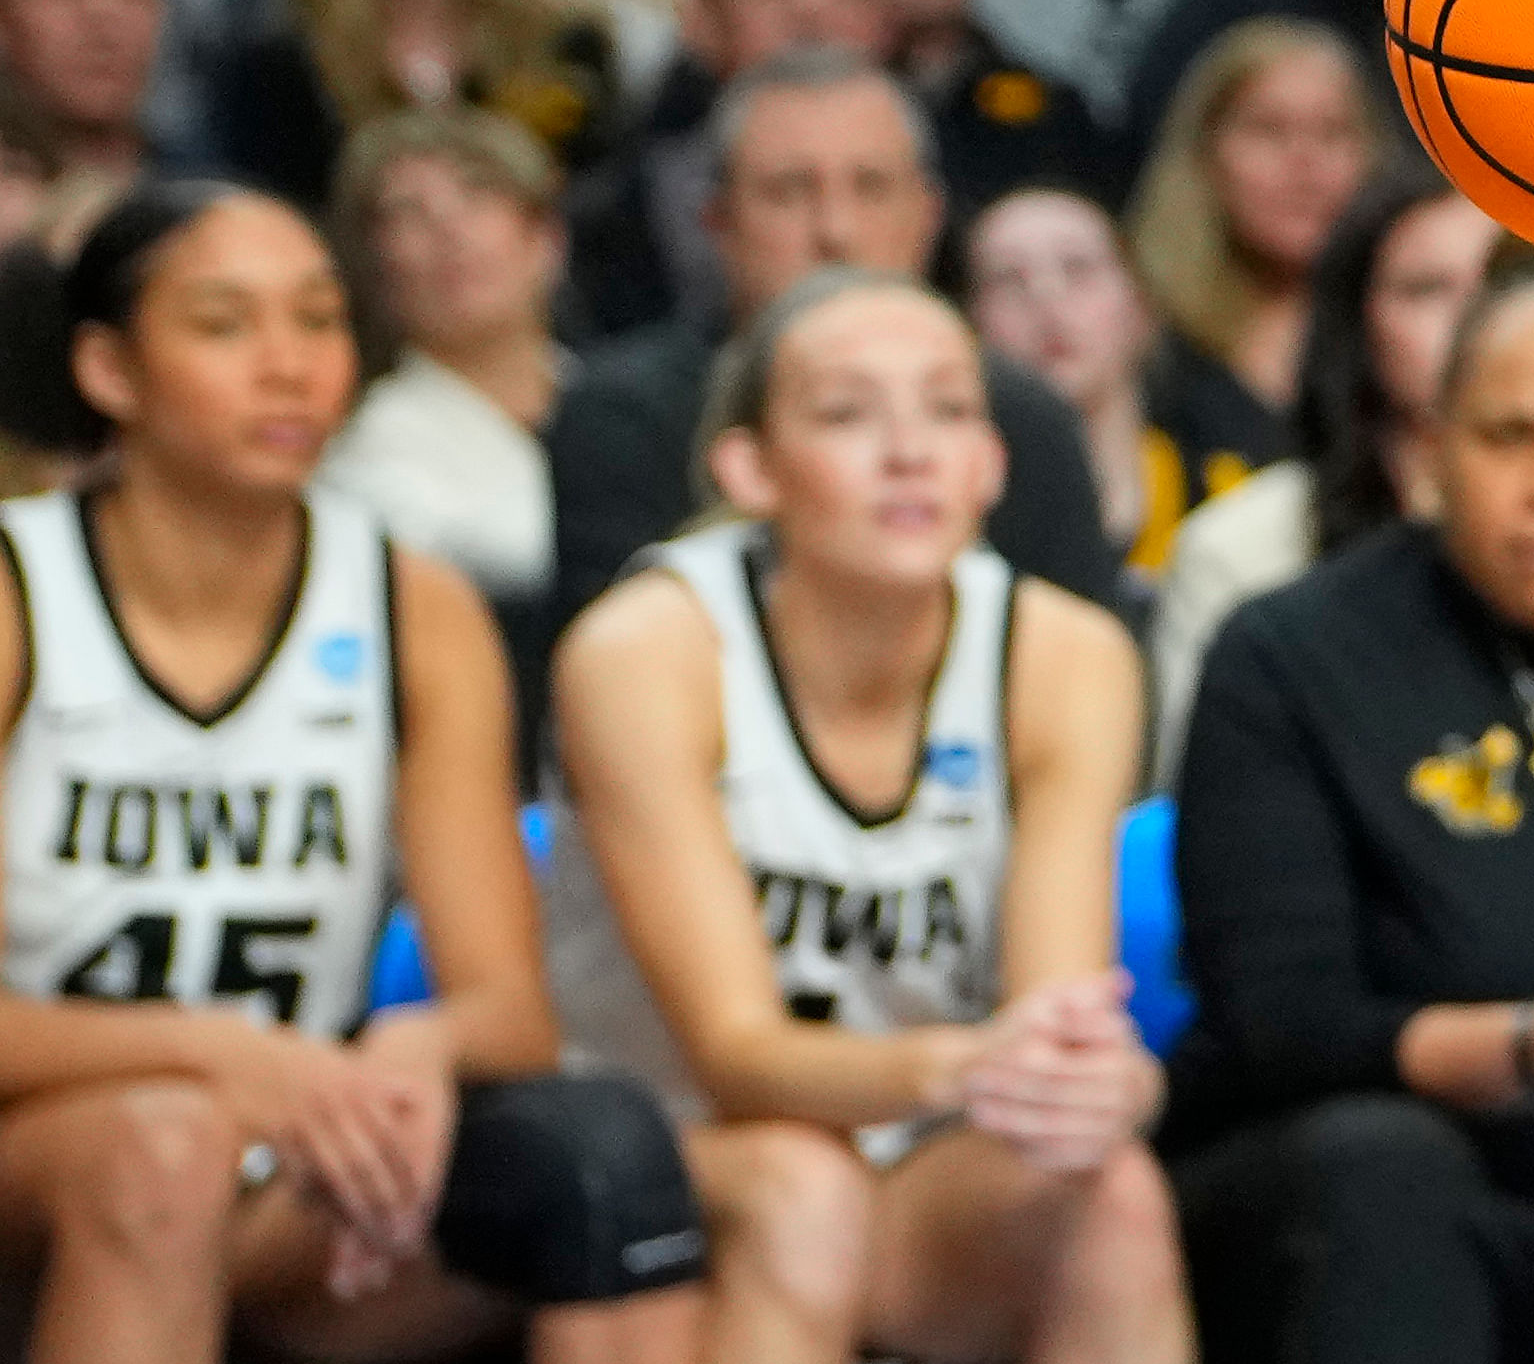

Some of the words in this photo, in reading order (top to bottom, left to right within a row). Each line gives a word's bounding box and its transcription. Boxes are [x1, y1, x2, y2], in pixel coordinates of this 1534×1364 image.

[57, 780, 348, 872] IOWA
[752, 867, 965, 969] OWA
[62, 915, 319, 1026] 45
